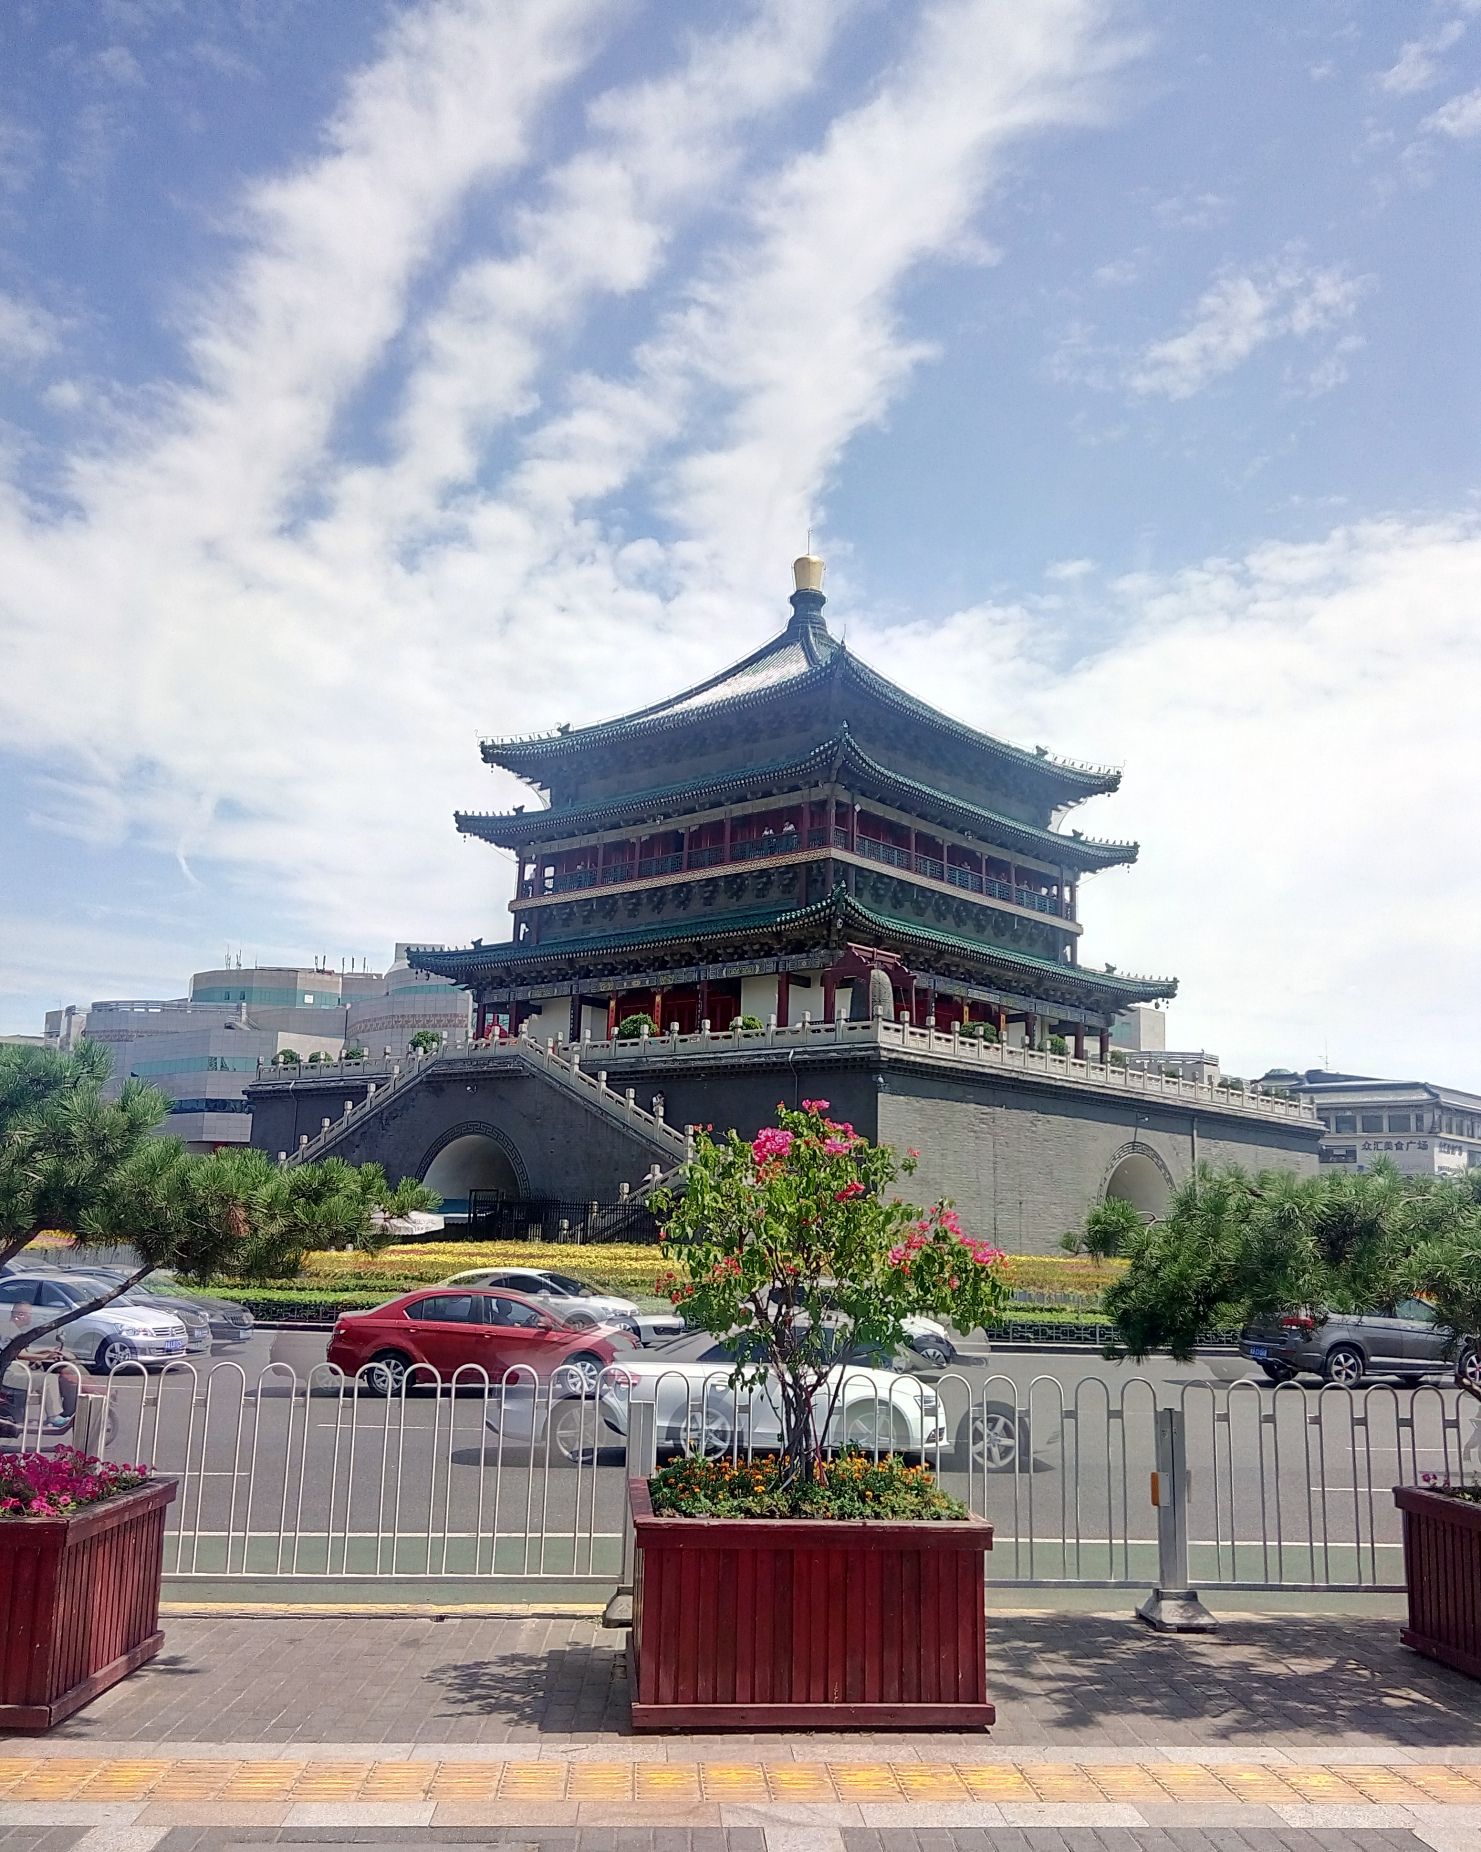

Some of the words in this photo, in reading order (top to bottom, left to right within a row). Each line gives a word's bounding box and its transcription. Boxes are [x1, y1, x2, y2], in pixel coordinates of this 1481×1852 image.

[1361, 1140, 1429, 1151] 众汇美食广场
